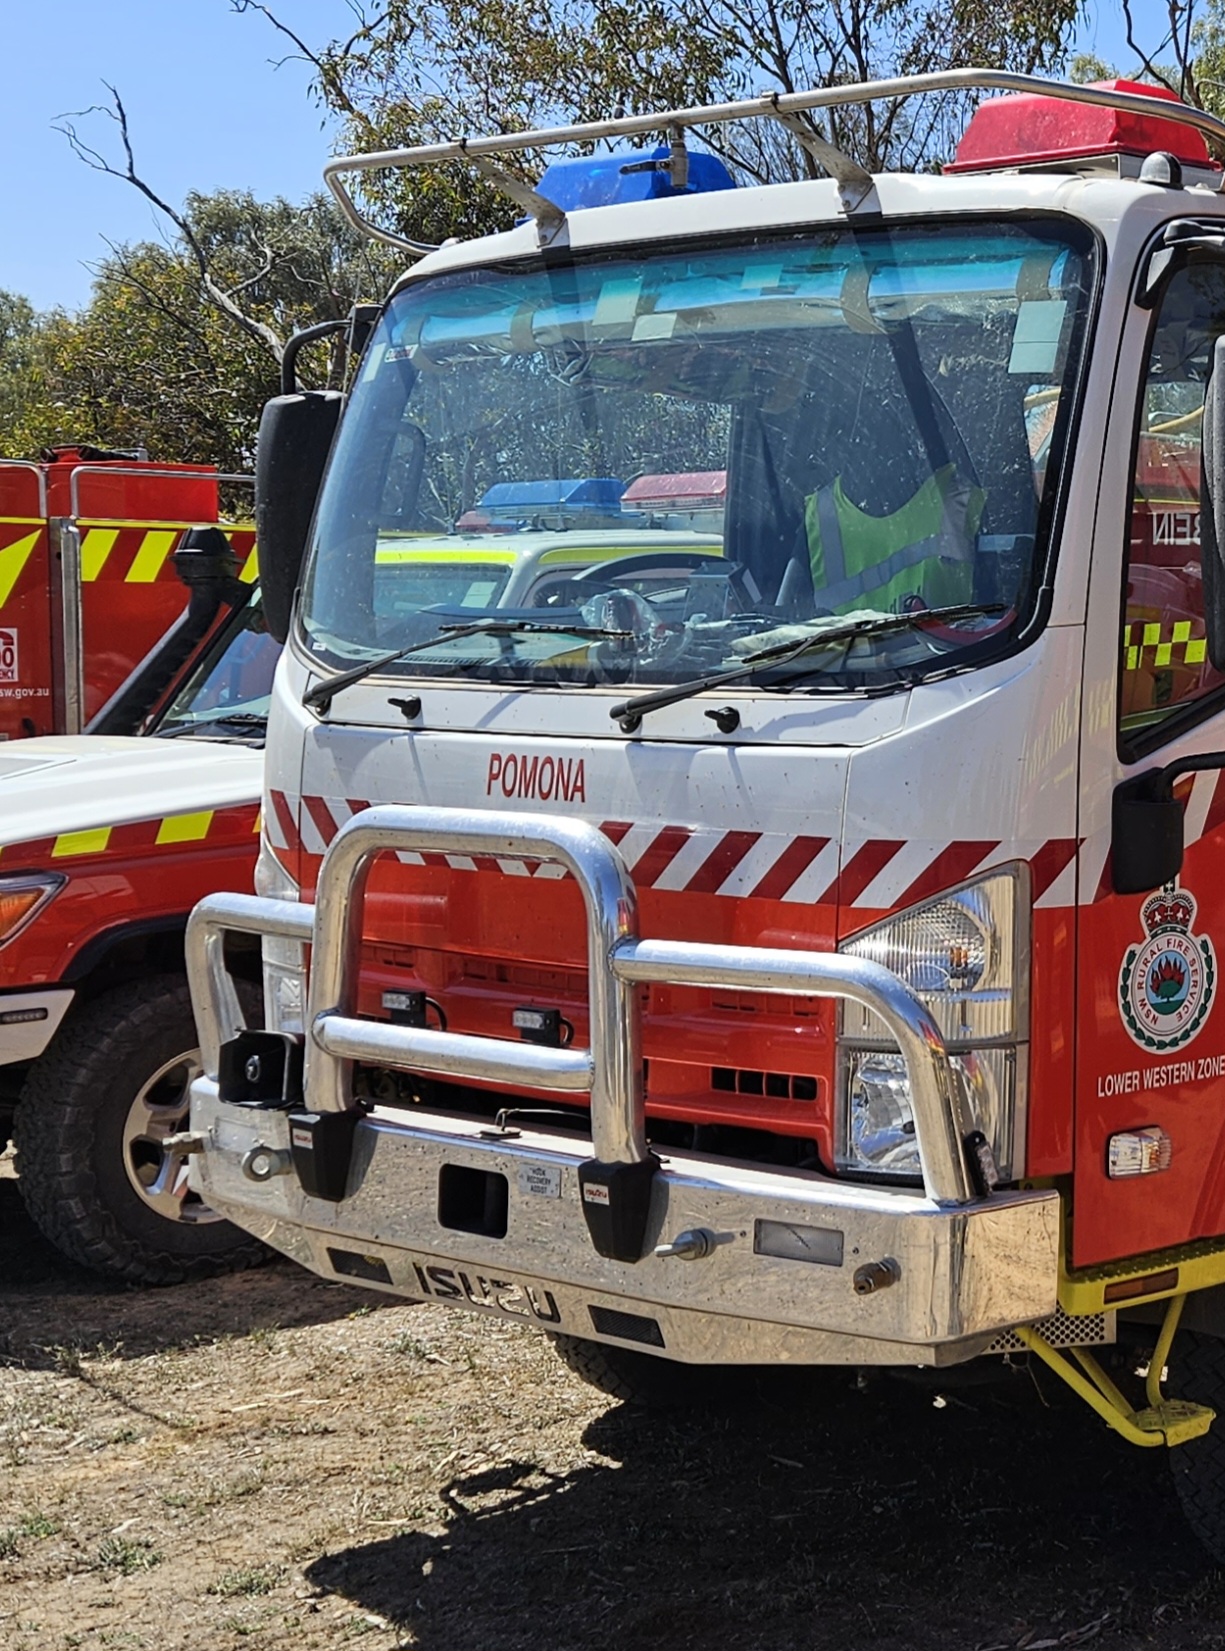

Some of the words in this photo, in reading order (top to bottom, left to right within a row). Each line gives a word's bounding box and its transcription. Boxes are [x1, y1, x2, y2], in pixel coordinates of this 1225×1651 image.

[487, 752, 586, 803] POMONA
[1137, 942, 1163, 990] RURAL
[1166, 938, 1191, 957] FIRE
[1138, 997, 1159, 1026] NSW
[1175, 957, 1199, 1023] SERVICE
[1098, 1070, 1140, 1098] LOWER
[1143, 1061, 1196, 1090] WESTERN
[412, 1261, 562, 1324] ISUZU
